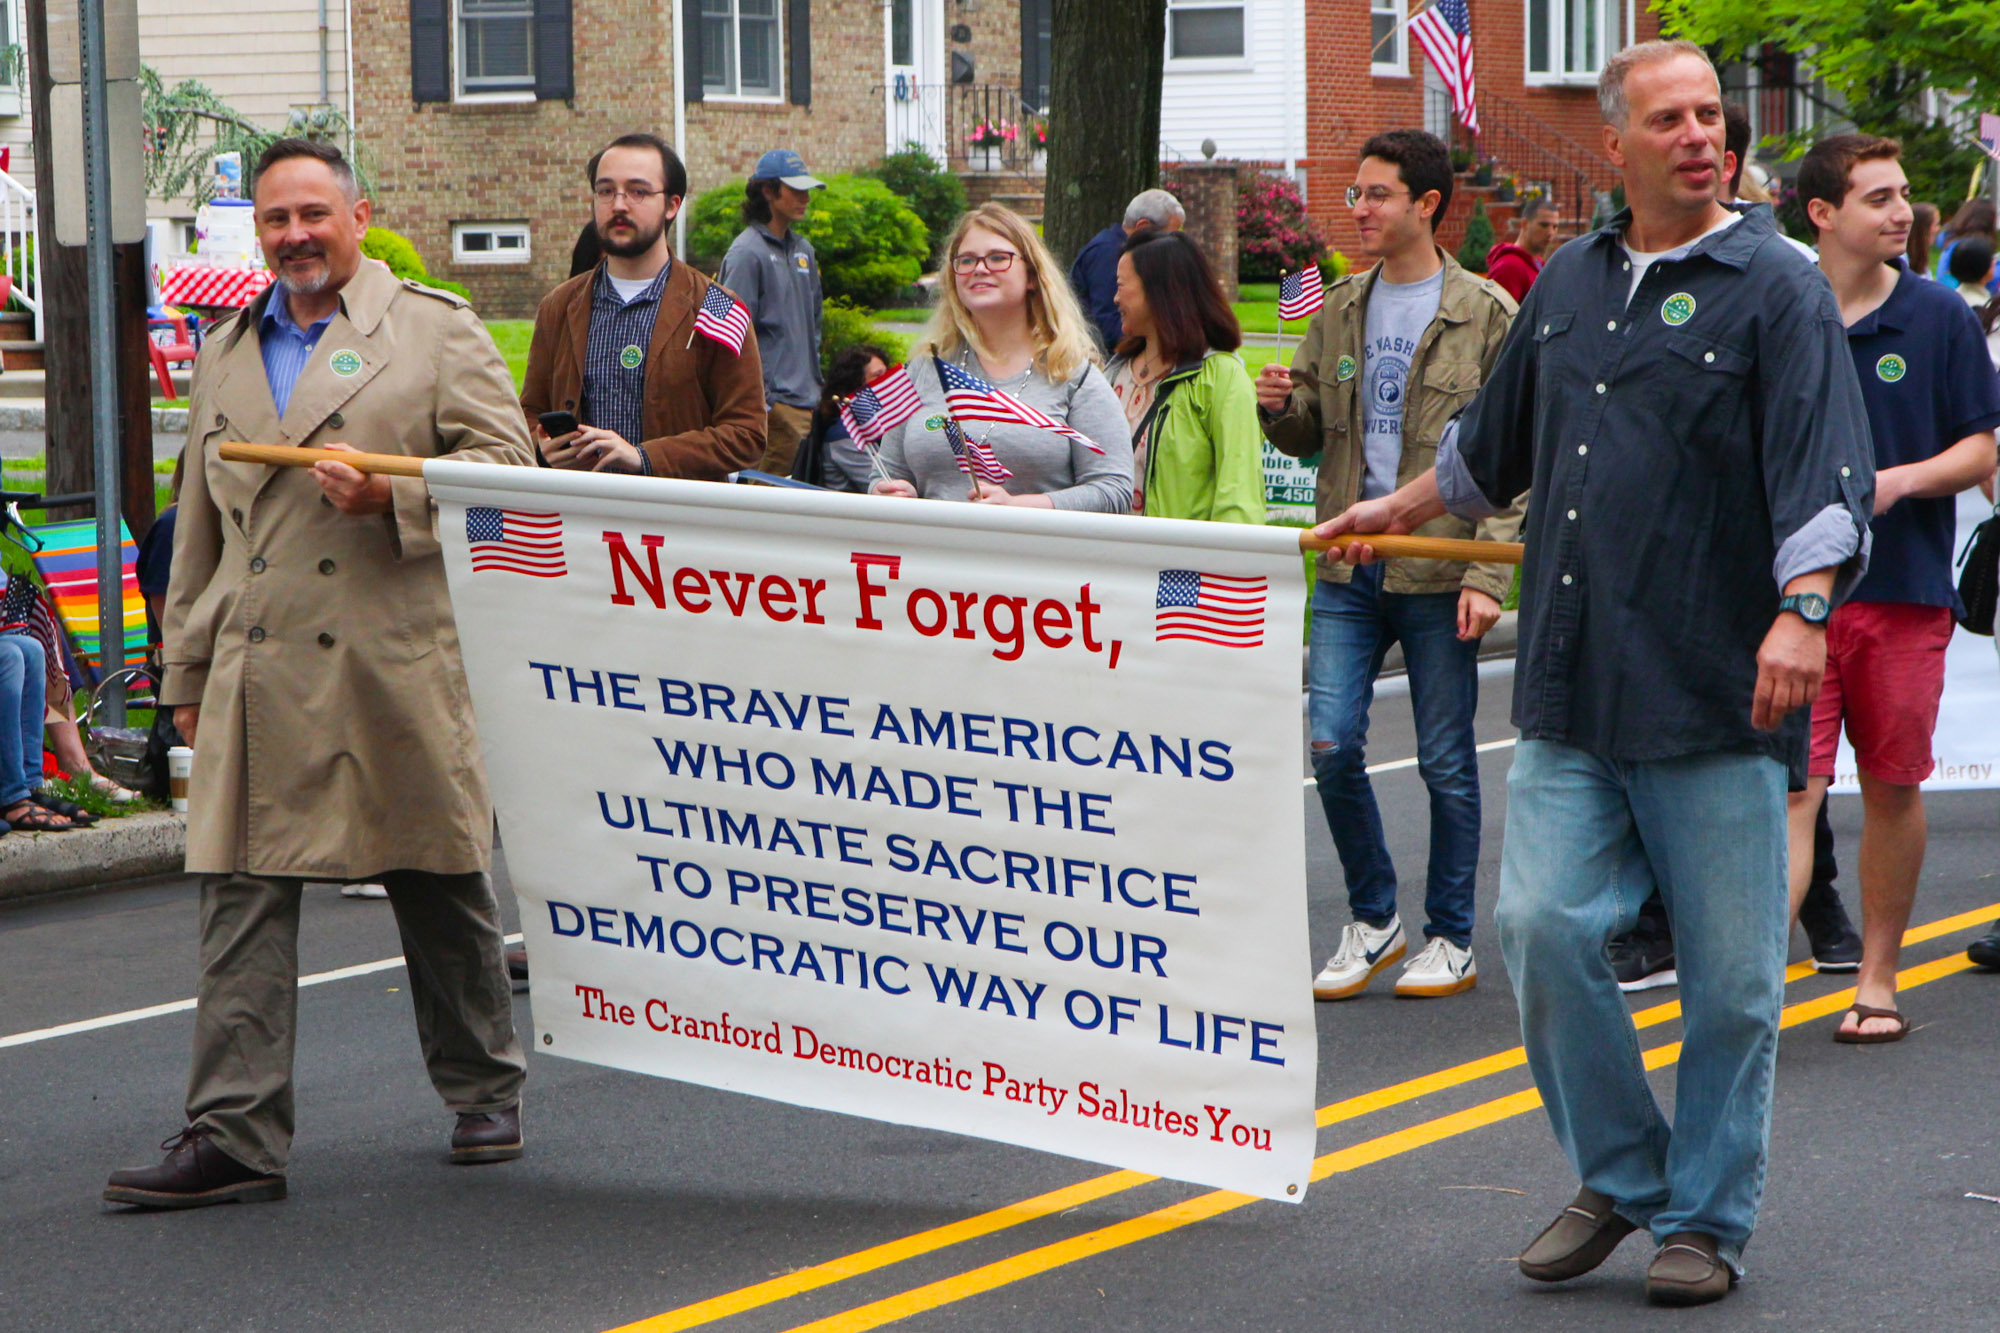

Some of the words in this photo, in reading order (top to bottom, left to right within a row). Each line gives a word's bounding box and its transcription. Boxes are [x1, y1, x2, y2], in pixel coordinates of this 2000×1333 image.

[1293, 476, 1310, 486] LLC
[602, 531, 826, 624] Never
[851, 552, 1122, 669] Forget,
[528, 660, 646, 712] THE
[657, 677, 855, 738] BRAVE
[870, 703, 1235, 782] AMERICANS
[1929, 757, 1993, 781] lergy
[652, 736, 796, 790] WHO
[810, 757, 982, 818] MADE
[993, 780, 1116, 836] THE
[596, 791, 873, 867] ULTIMATE
[886, 833, 1200, 916] SACRIFICE
[636, 854, 712, 899] TO
[726, 868, 1028, 955] PRESERVE
[1043, 920, 1169, 978] OUR
[546, 900, 912, 995] DEMOCRATIC
[924, 962, 1048, 1020] WAY
[1064, 989, 1141, 1035] OF
[1158, 1003, 1286, 1067] LIFE
[575, 984, 636, 1026] The
[645, 999, 783, 1054] Cranford
[791, 1025, 973, 1091] Democratic
[982, 1061, 1068, 1116] Party
[1077, 1081, 1200, 1138] Salutes
[1204, 1104, 1273, 1152] You
